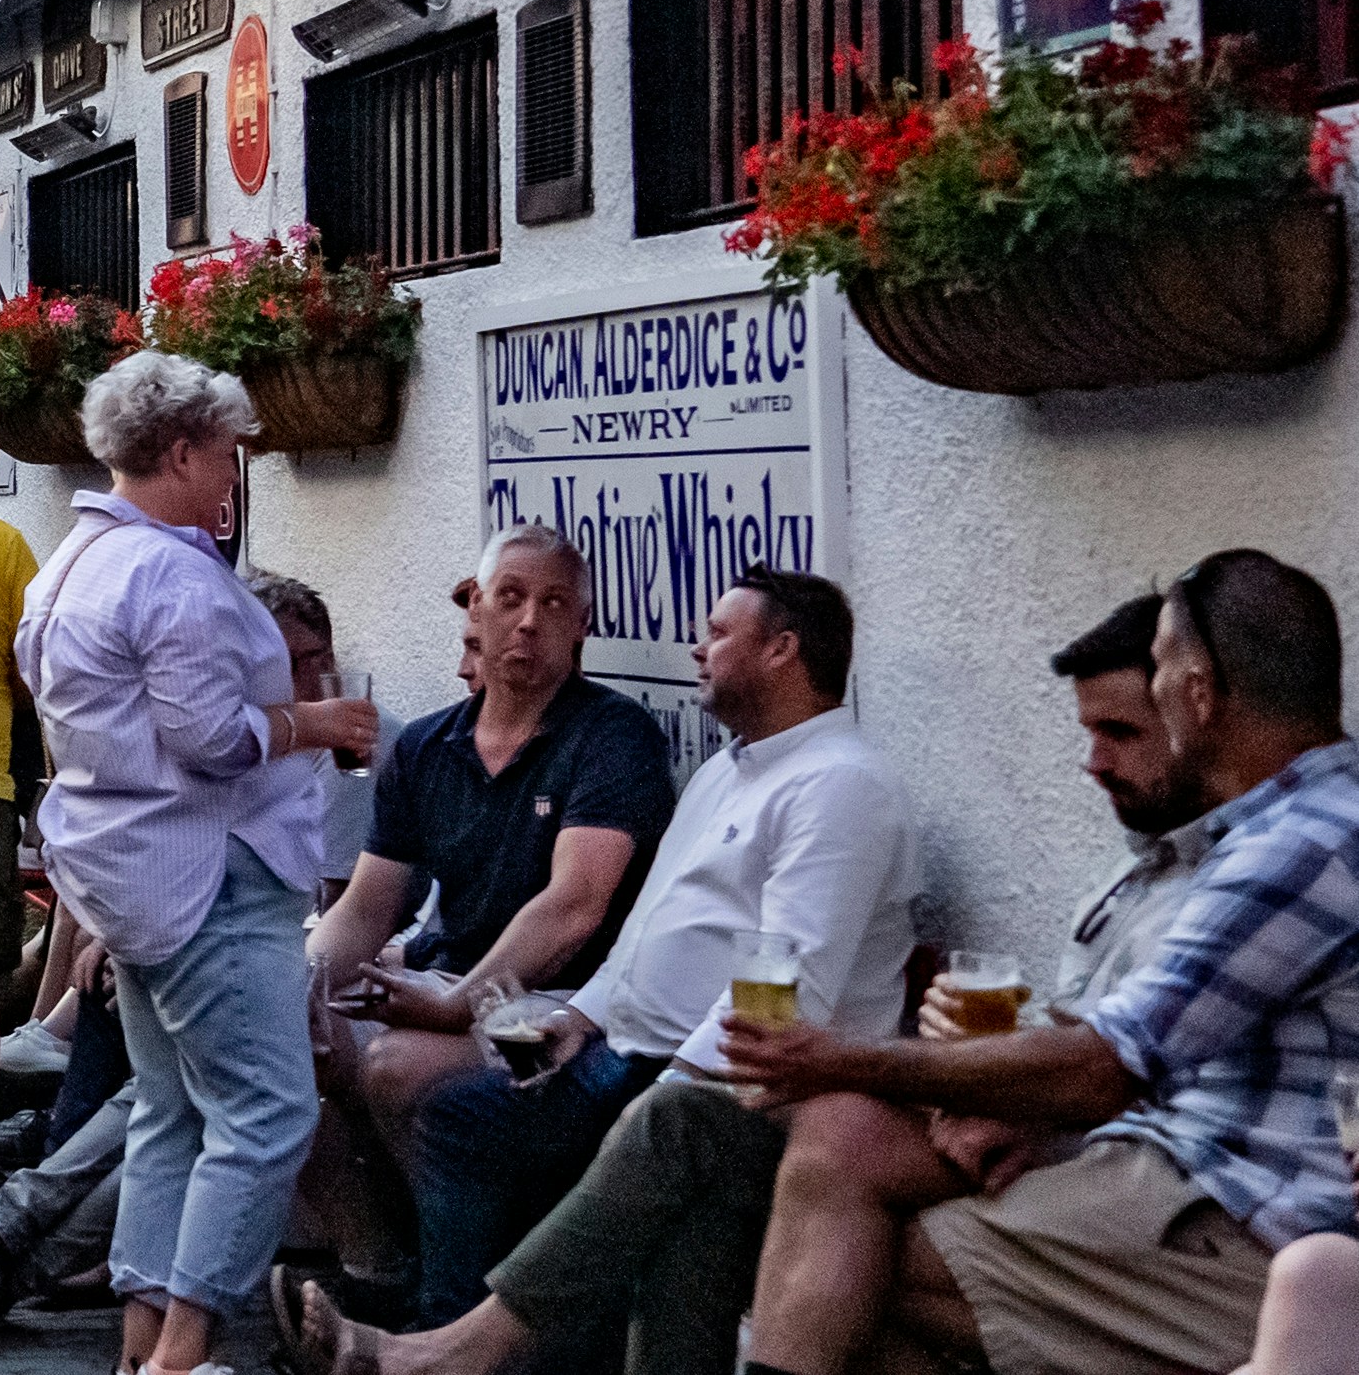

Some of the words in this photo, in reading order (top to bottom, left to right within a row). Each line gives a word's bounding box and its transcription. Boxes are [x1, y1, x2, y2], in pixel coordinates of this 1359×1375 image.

[53, 42, 83, 90] DRIVE
[495, 327, 589, 405] DUNCAN,
[593, 309, 737, 398] ALDERDICE
[745, 317, 761, 384] &
[572, 406, 698, 443] NEWRY
[736, 395, 792, 413] LIMITED
